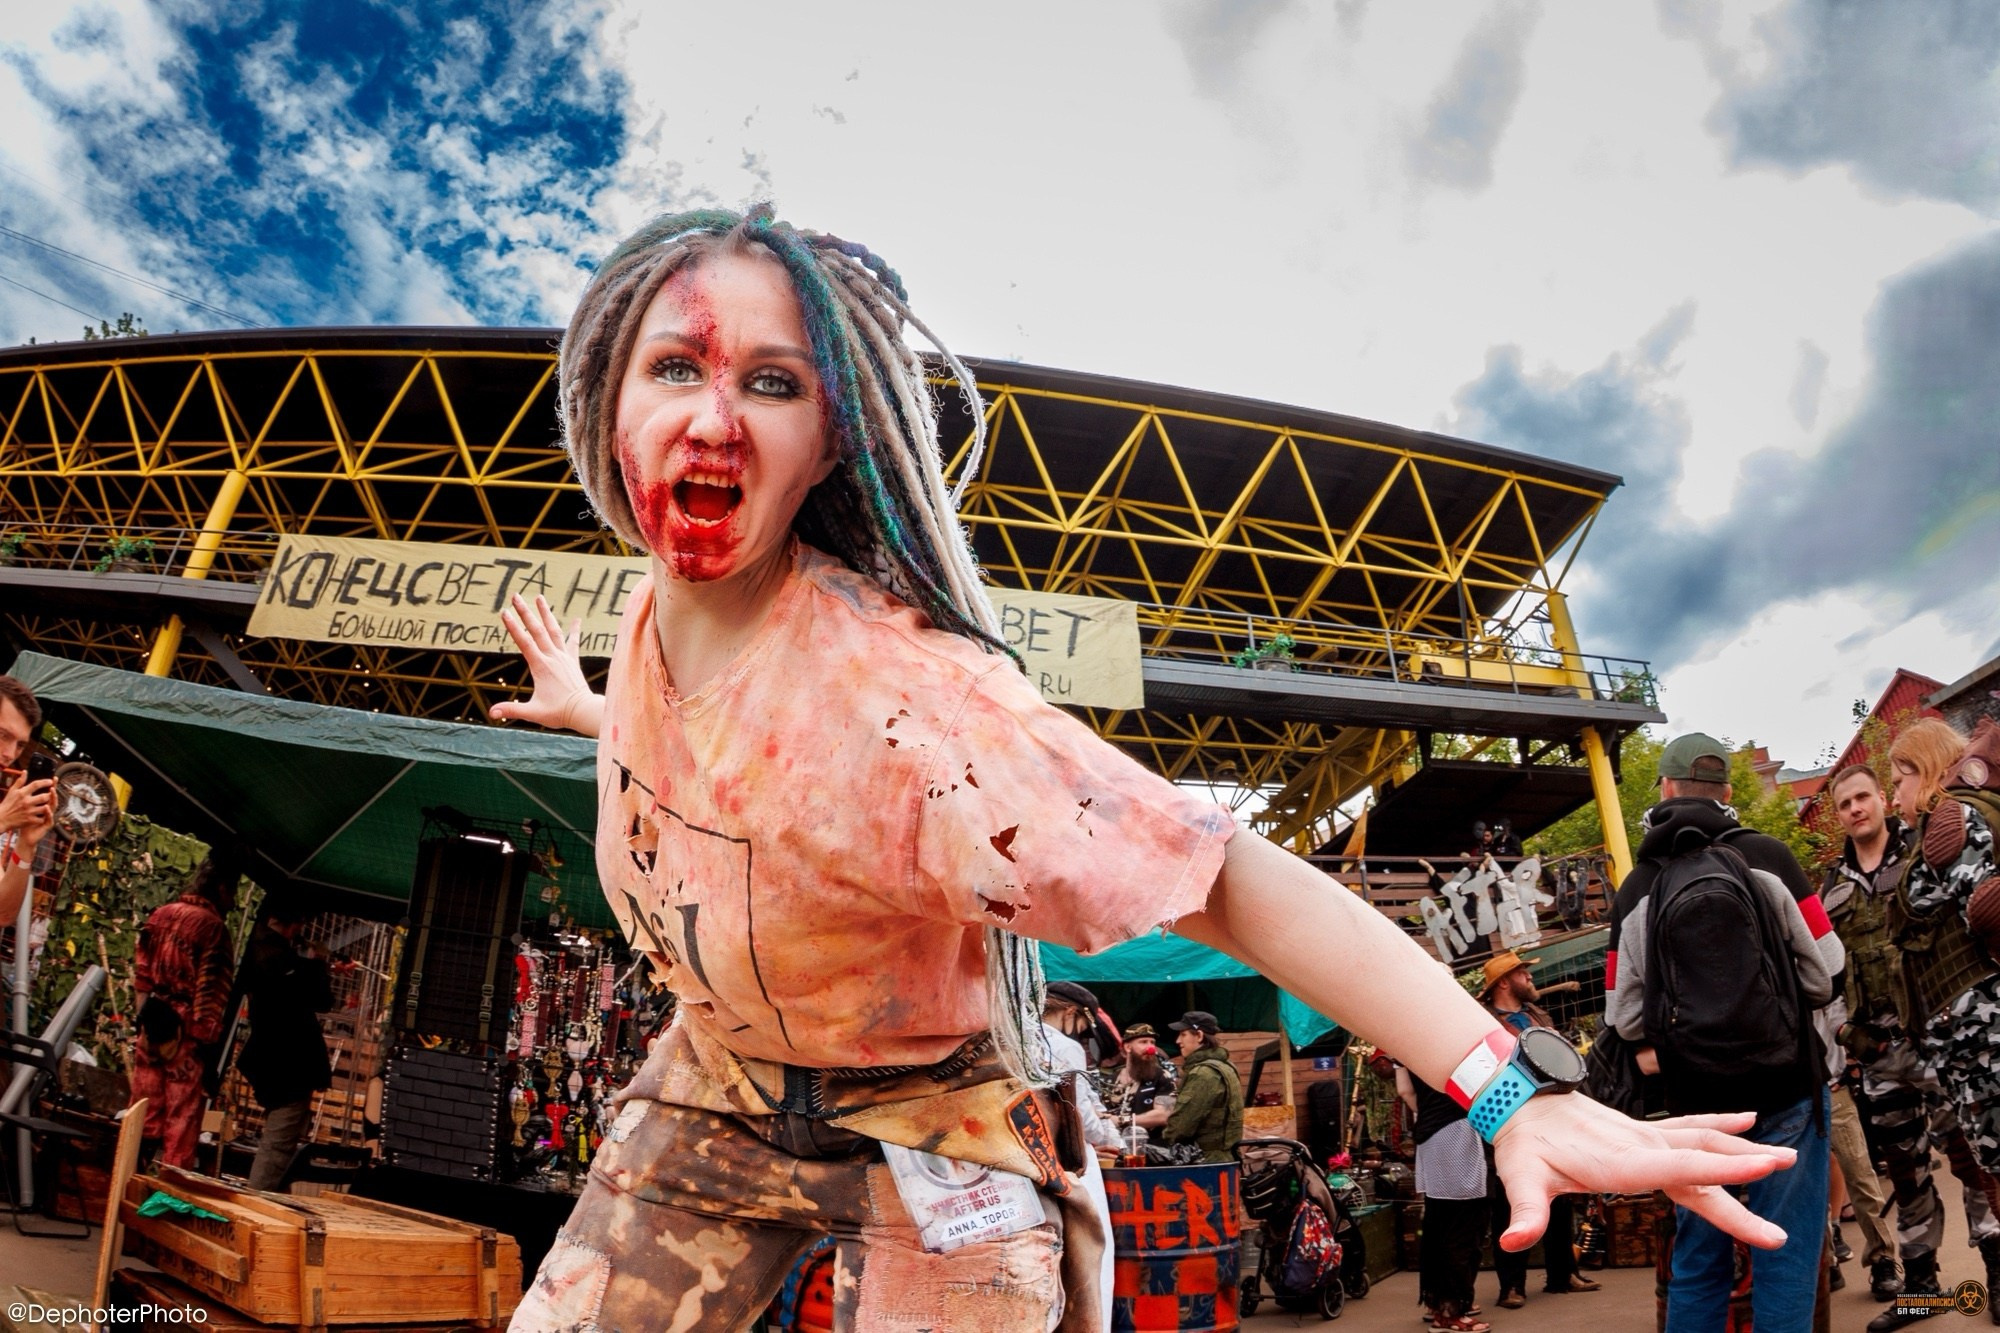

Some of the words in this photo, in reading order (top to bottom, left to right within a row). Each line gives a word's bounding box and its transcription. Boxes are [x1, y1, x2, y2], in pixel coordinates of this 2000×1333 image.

[328, 611, 424, 642] БОЛЬШОЙ
[1001, 603, 1098, 658] ВЕТ
[953, 1199, 987, 1217] AFTER
[986, 1194, 1002, 1207] US
